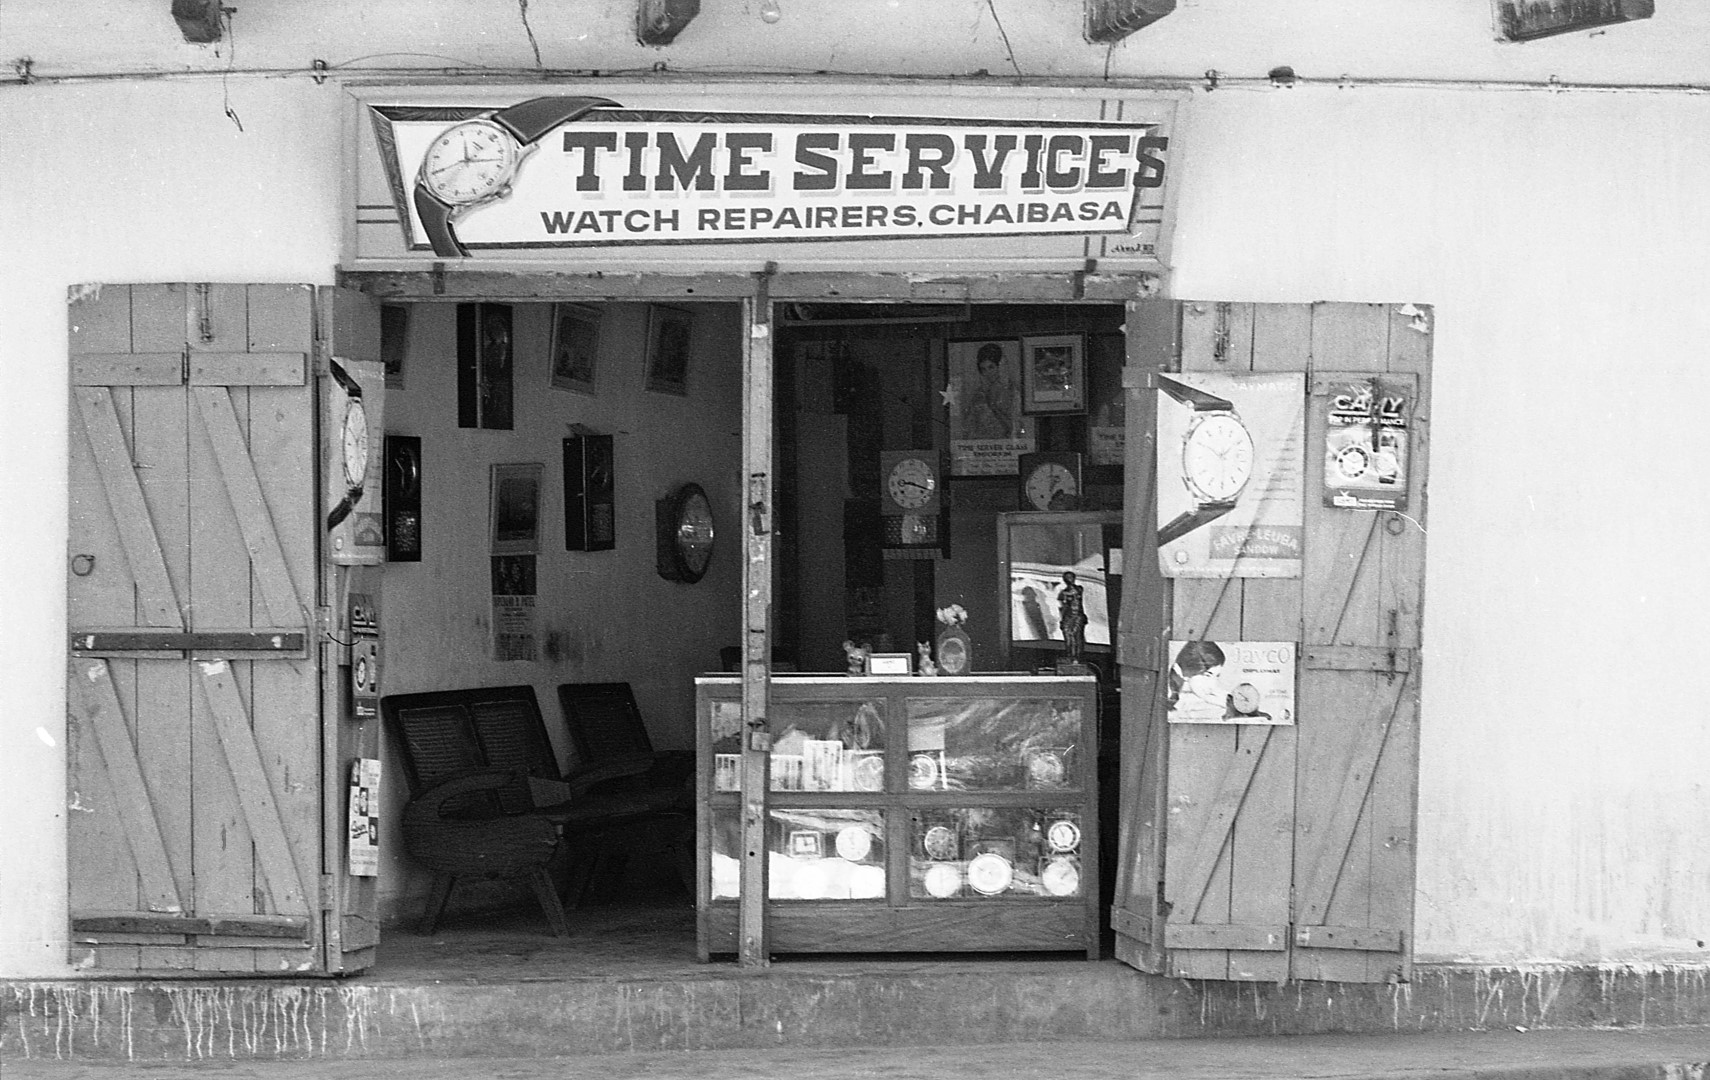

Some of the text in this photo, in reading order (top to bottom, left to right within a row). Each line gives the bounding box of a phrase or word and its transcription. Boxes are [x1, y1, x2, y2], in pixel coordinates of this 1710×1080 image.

[563, 131, 1169, 191] TIME SERVICES
[540, 208, 680, 235] WATCH
